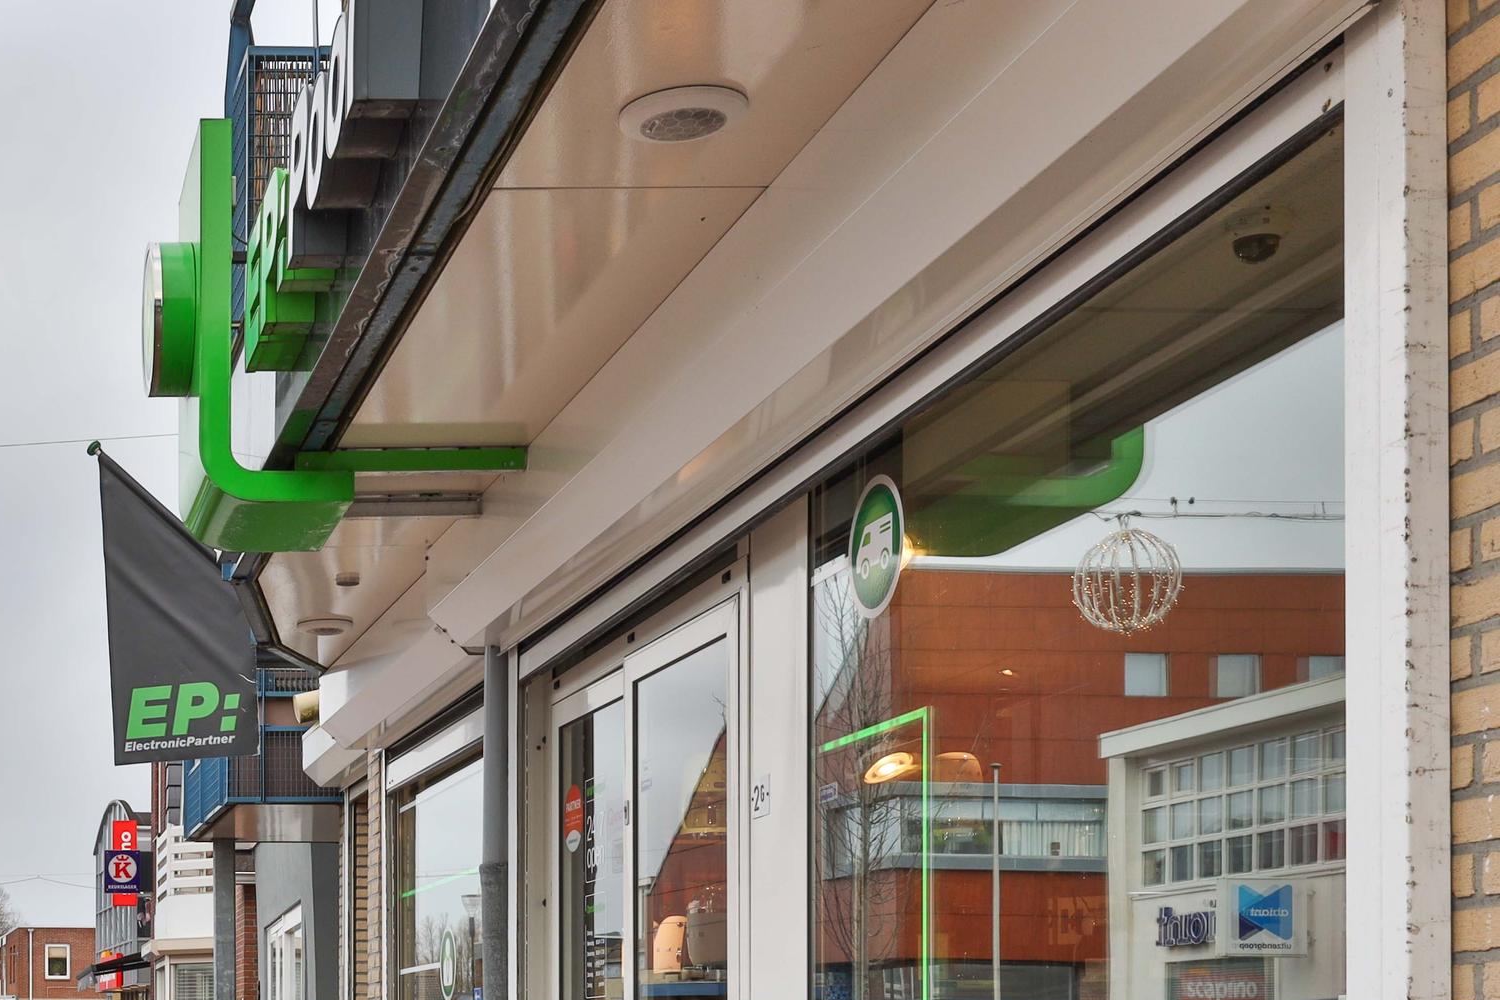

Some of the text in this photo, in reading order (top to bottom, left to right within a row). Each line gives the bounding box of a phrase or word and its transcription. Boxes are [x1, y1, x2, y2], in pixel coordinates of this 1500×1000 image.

[126, 681, 241, 740] EP:
[124, 735, 236, 753] ElectronicPartner
[113, 862, 132, 879] K
